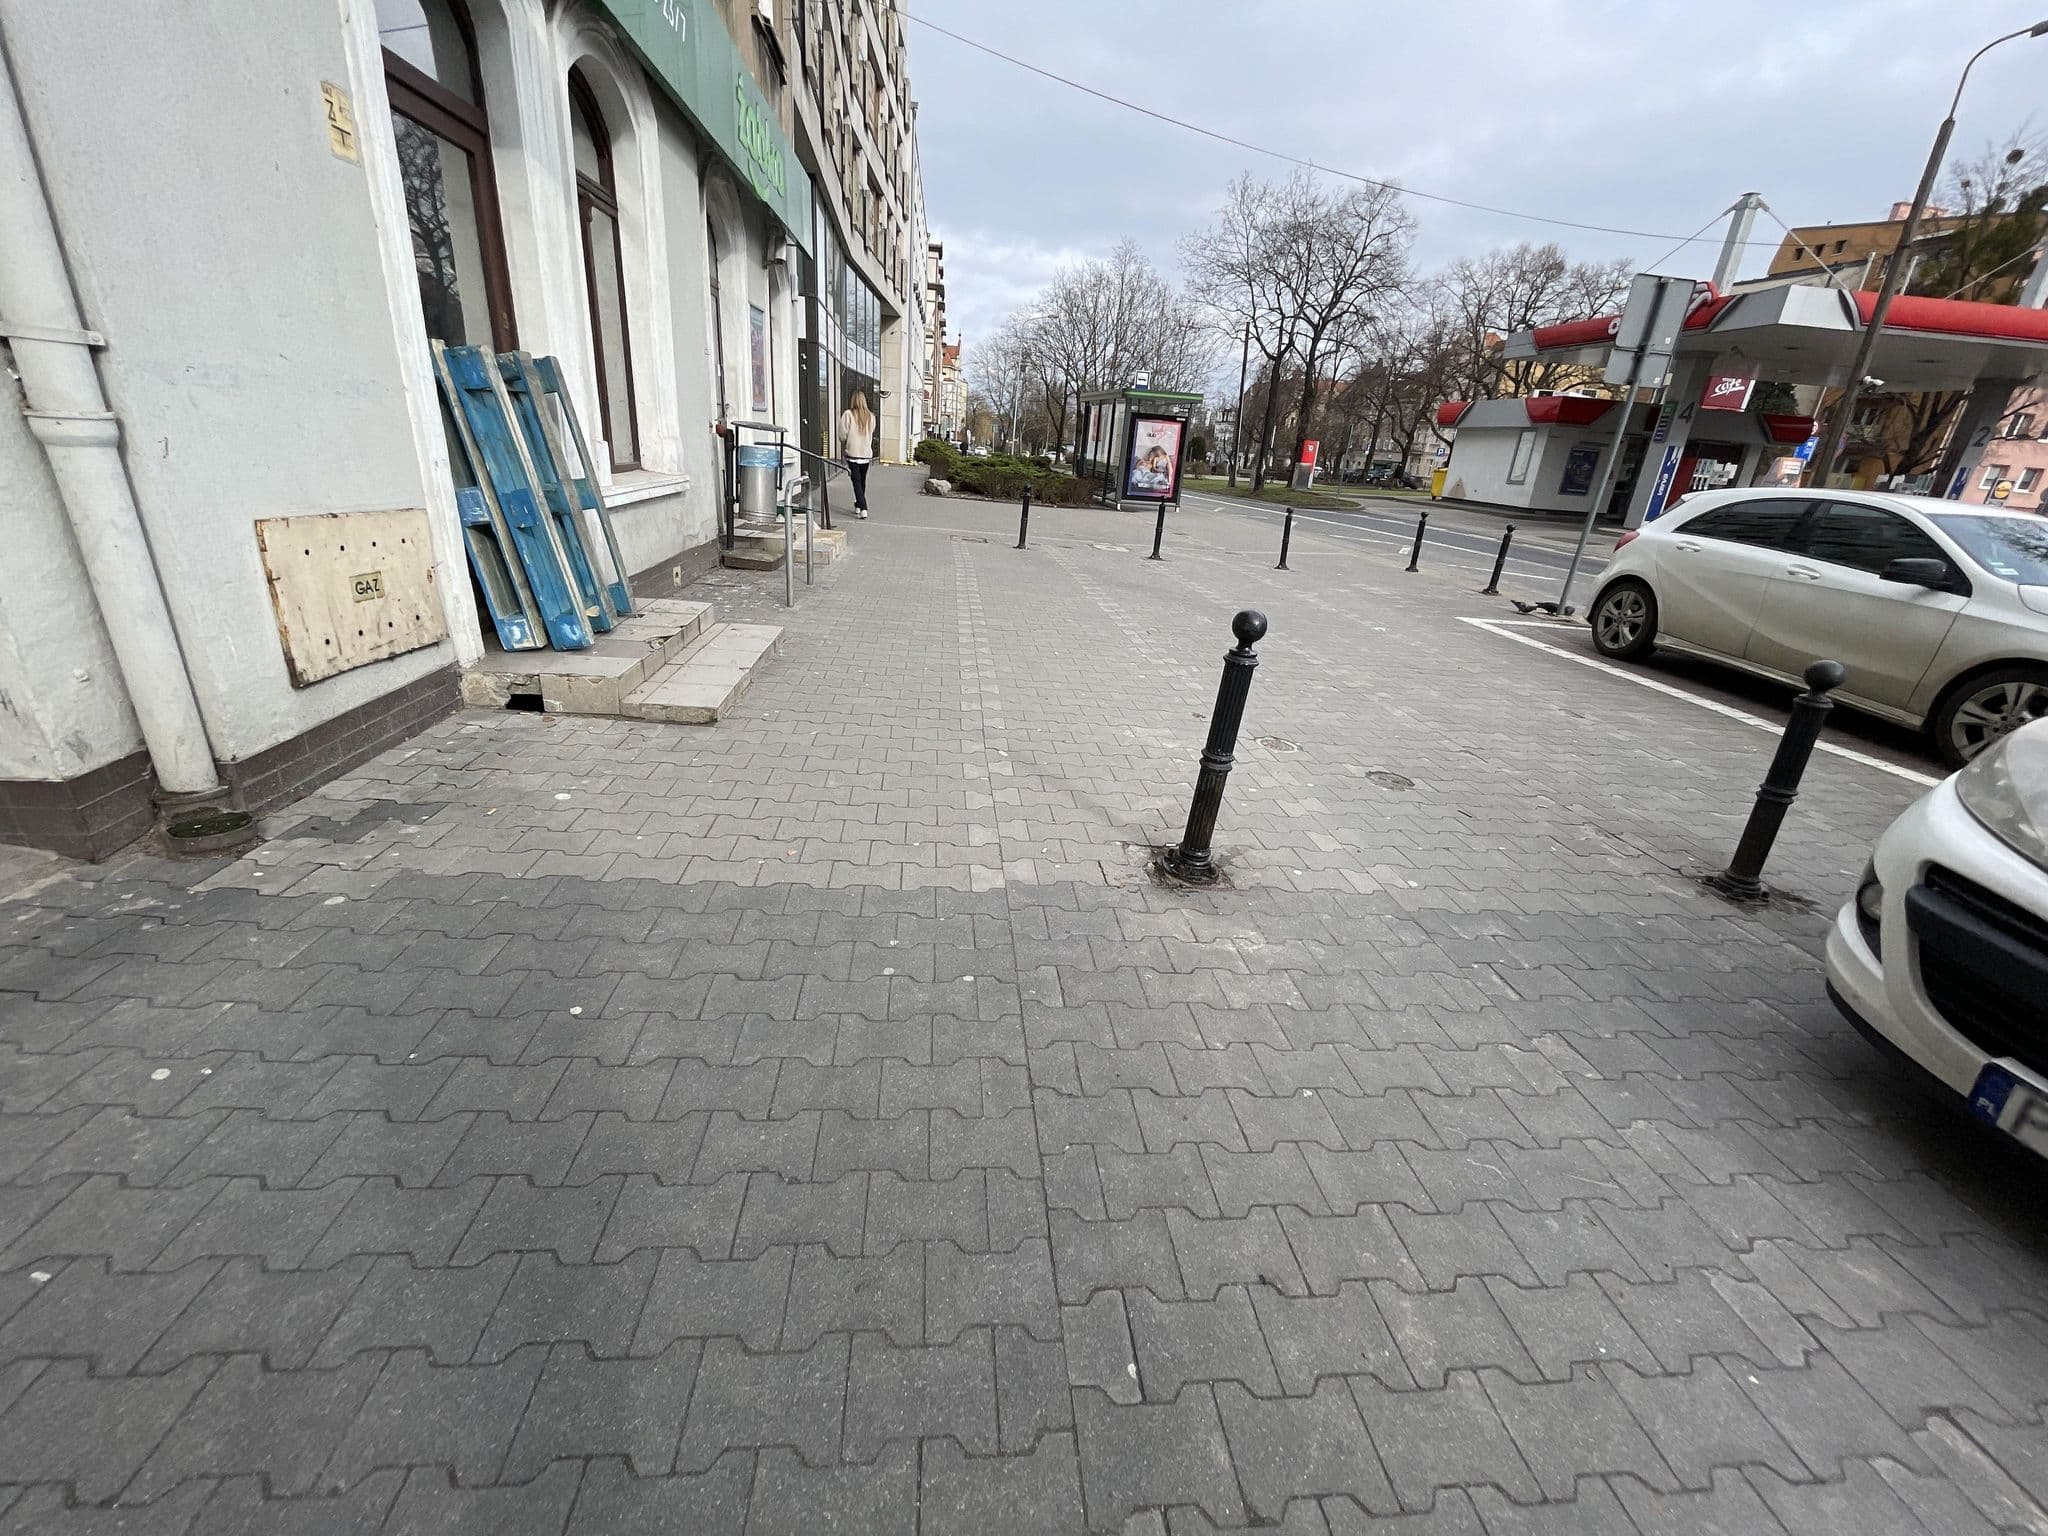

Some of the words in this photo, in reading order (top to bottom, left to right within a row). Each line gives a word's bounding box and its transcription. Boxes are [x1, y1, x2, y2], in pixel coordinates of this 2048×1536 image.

[1677, 401, 1695, 423] 4
[1973, 425, 1991, 447] 2
[355, 578, 381, 595] GAZ
